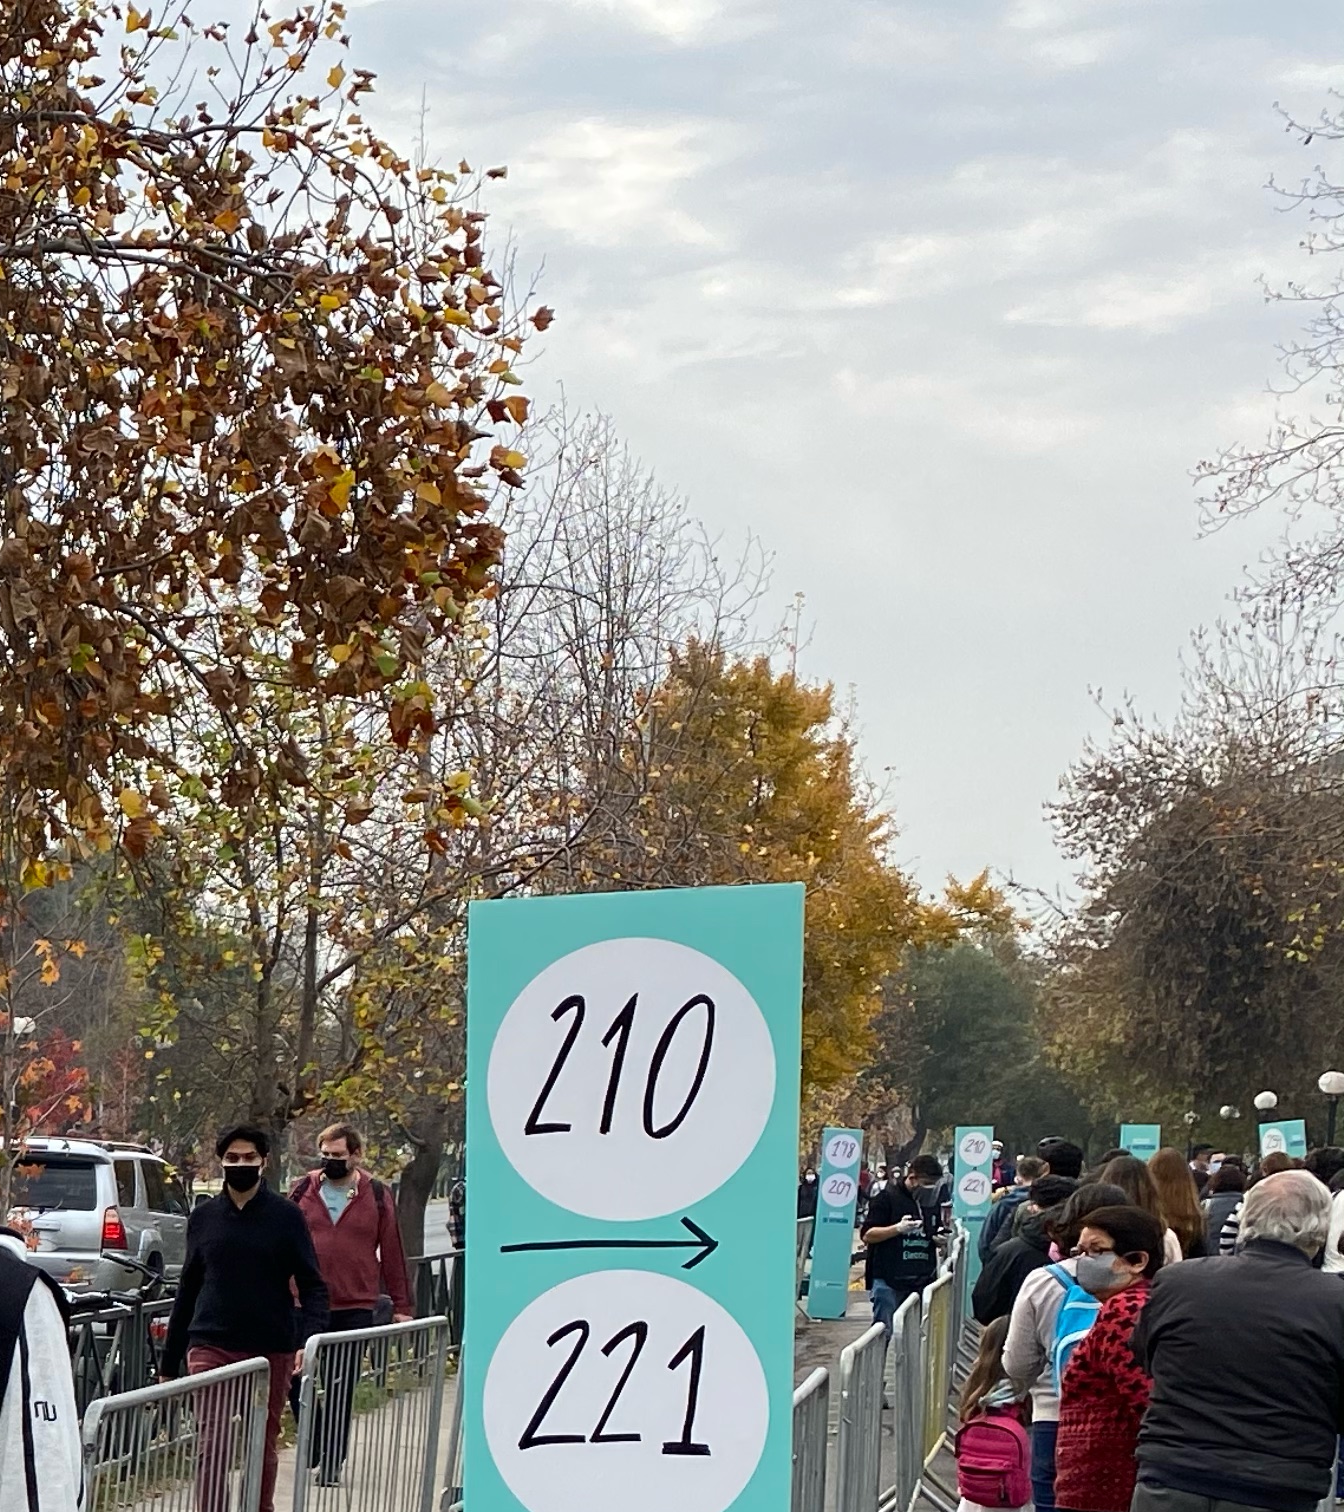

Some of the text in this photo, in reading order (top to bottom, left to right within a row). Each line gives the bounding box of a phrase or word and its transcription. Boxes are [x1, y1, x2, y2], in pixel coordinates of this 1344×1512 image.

[525, 993, 715, 1139] 210
[831, 1140, 856, 1159] 198
[964, 1139, 986, 1154] 210
[828, 1180, 852, 1197] 209
[963, 1179, 985, 1195] 221
[518, 1320, 710, 1455] 221
